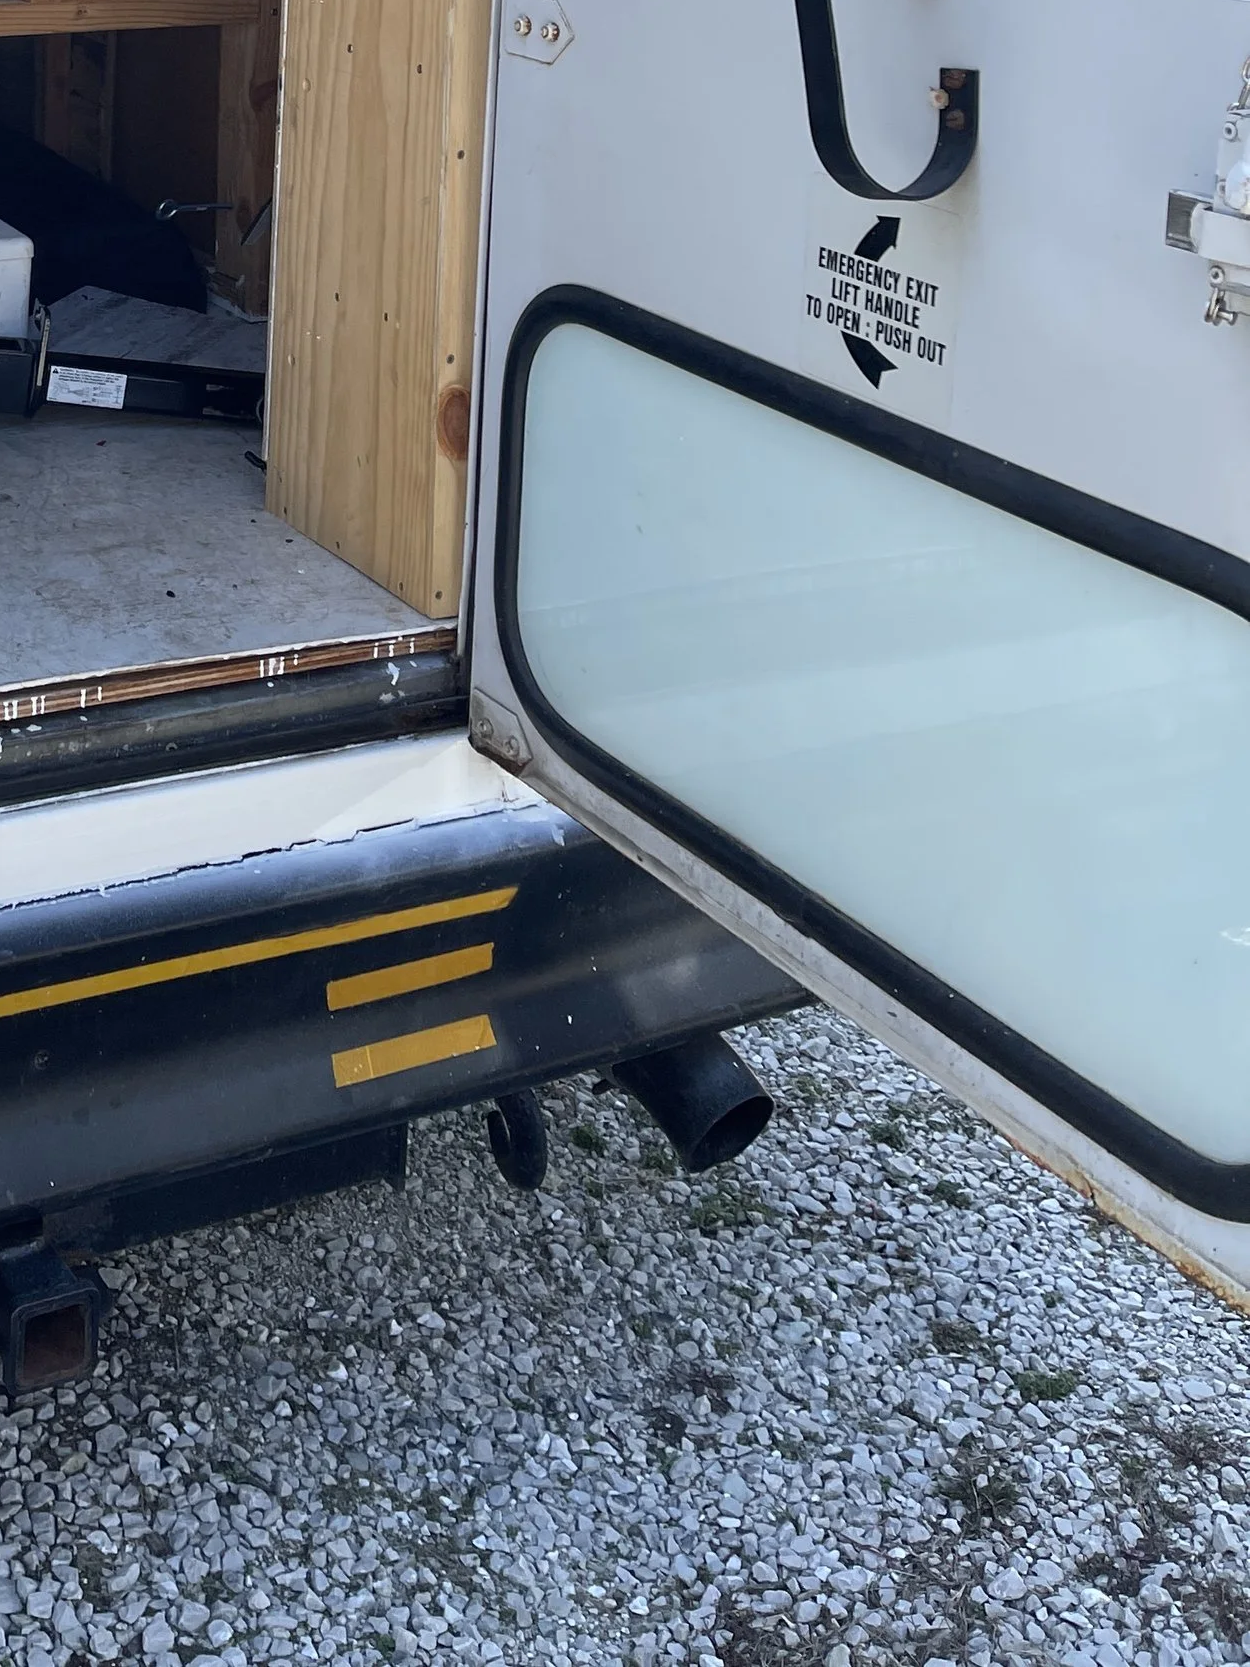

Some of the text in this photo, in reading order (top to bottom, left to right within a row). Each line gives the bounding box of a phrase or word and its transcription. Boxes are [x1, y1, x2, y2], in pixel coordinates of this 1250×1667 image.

[817, 245, 940, 308] EMERGENCY EXIT
[831, 276, 921, 330] LIFT HANDLE
[805, 293, 822, 320] TO
[826, 301, 862, 335] OPEN
[875, 319, 913, 354] PUSH
[917, 335, 947, 367] OUT
